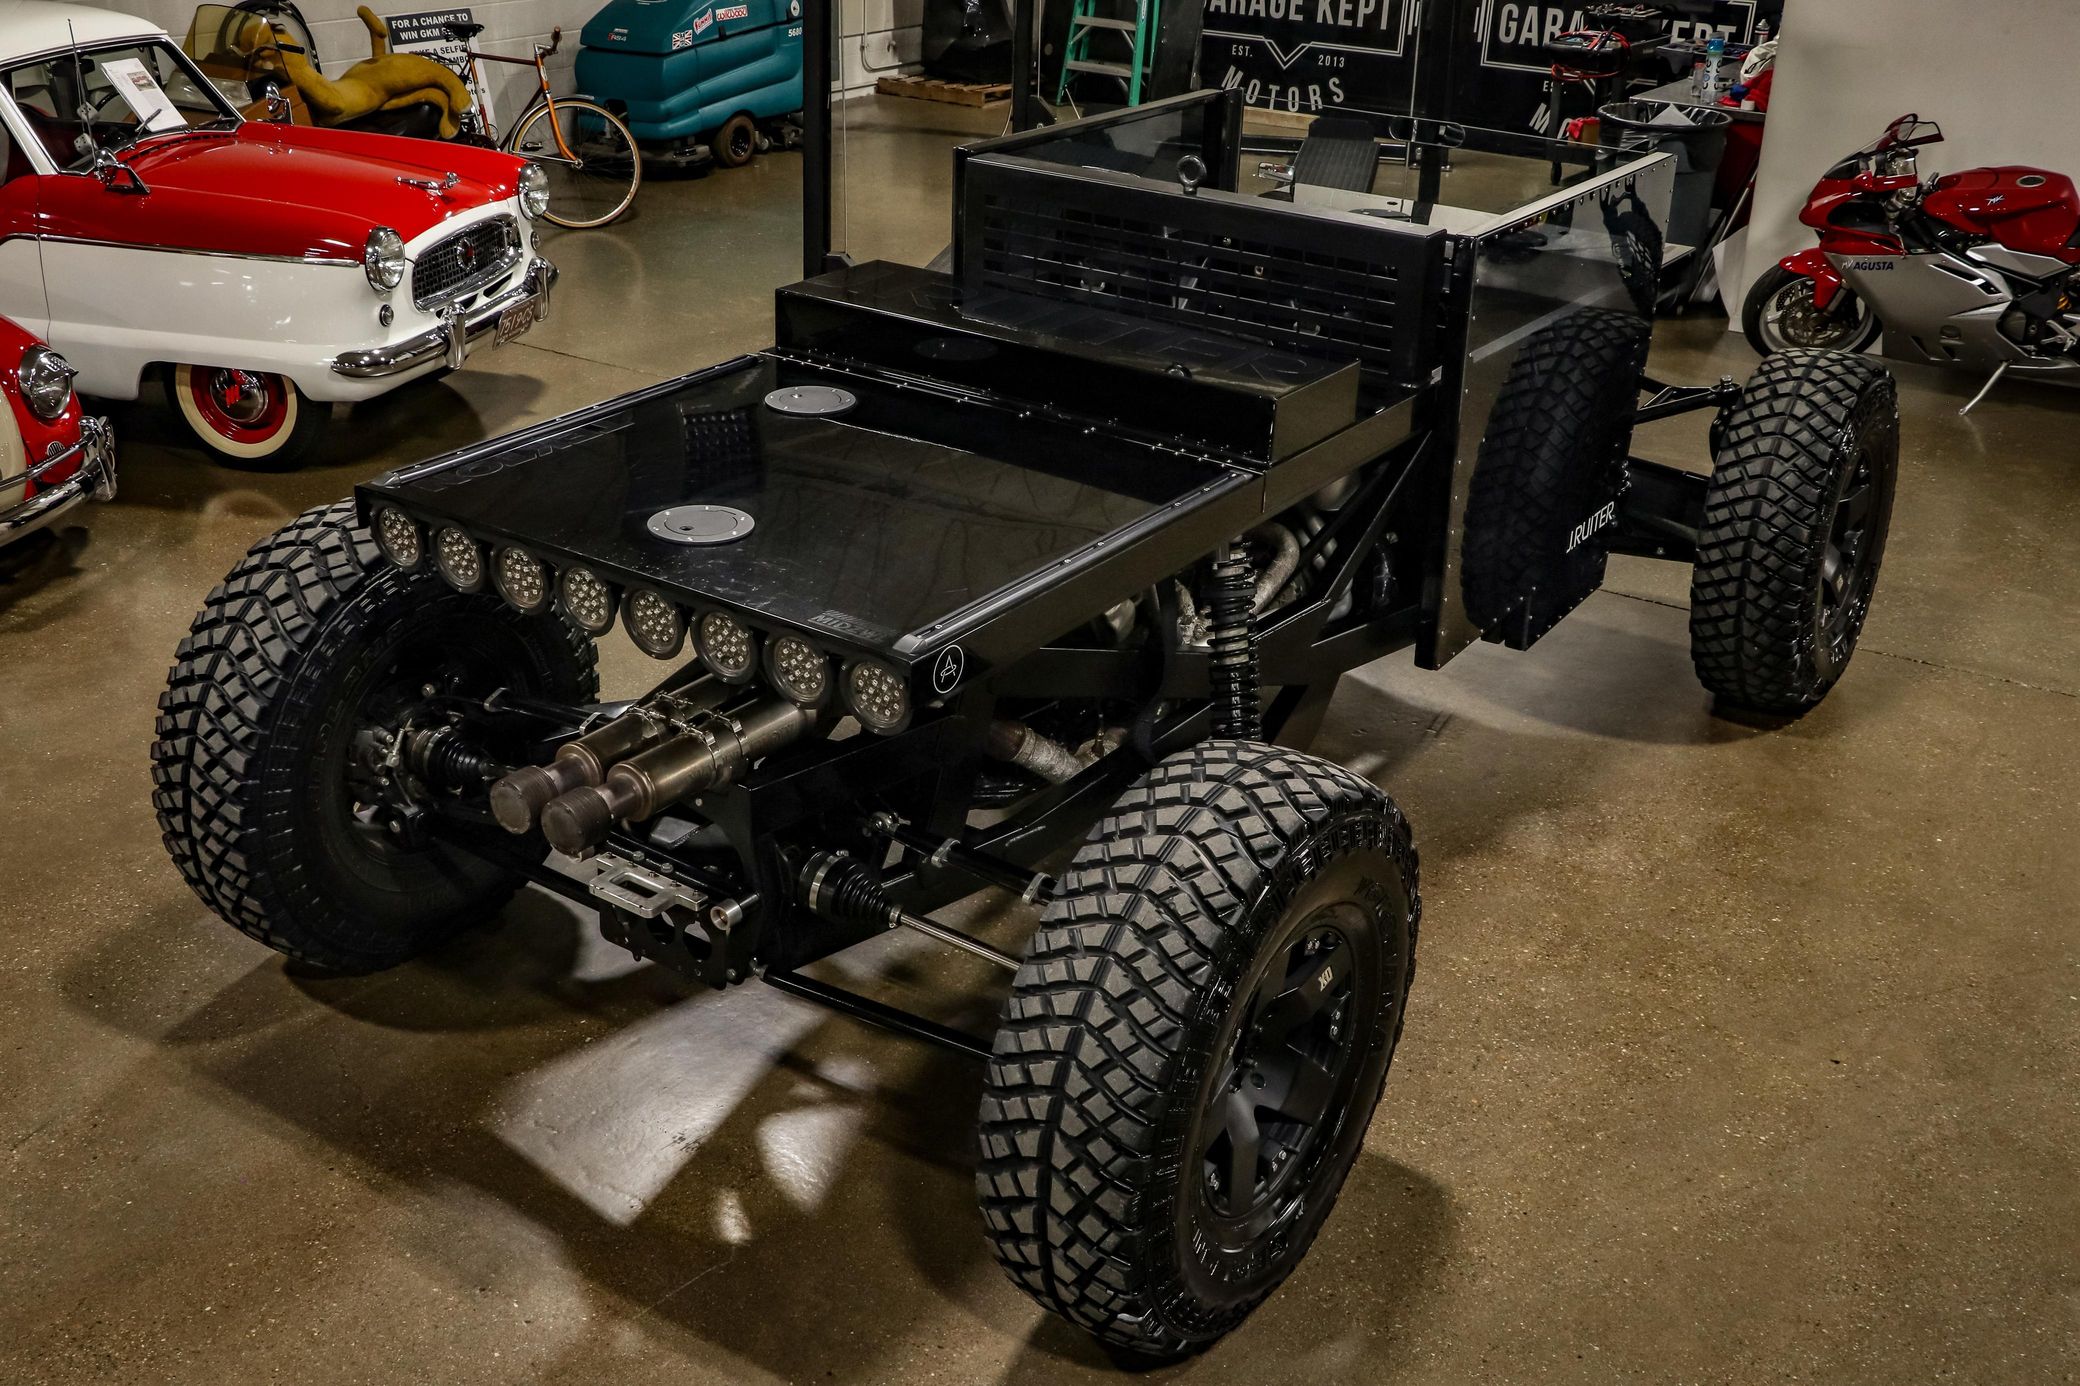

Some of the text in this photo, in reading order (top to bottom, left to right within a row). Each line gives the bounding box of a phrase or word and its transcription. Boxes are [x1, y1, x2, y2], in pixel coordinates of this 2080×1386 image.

[1203, 0, 1304, 21] AGE
[391, 13, 468, 29] FOR A CHANCE TO
[1499, 3, 1738, 47] GARA EPT
[400, 31, 418, 40] WIN
[420, 28, 440, 38] GKM
[1232, 44, 1253, 57] EST.
[1318, 54, 1345, 68] 2013
[1221, 65, 1345, 112] MOTORS
[1853, 261, 1894, 271] AGUSTA
[1566, 501, 1614, 554] J.RUITER
